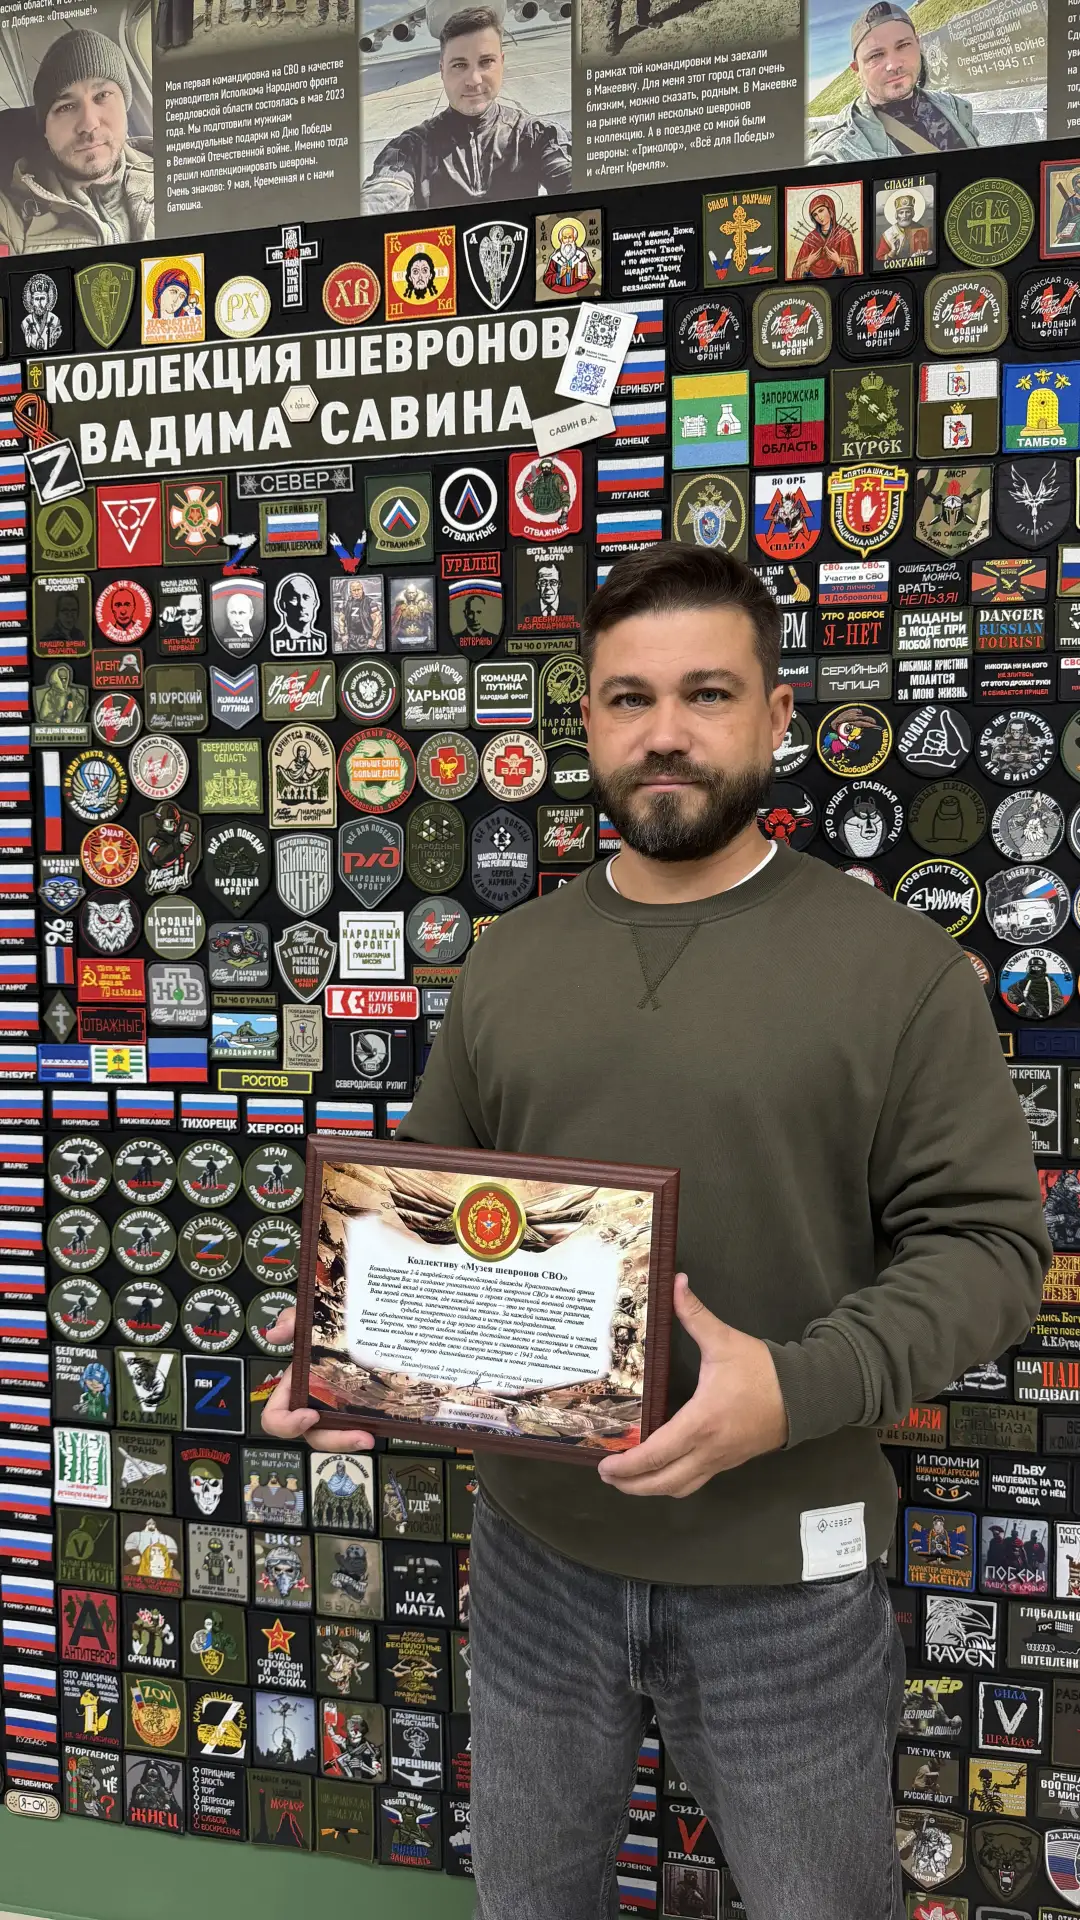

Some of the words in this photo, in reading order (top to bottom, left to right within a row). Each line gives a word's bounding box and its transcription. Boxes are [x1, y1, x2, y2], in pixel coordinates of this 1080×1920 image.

[2, 19, 9, 28] от
[12, 15, 44, 28] Добряка:
[47, 5, 97, 20] «Отважные!»
[958, 48, 1013, 67] Отечественной
[1016, 36, 1045, 53] войне
[587, 69, 592, 80] В
[595, 68, 626, 81] рамках
[629, 63, 643, 75] той
[645, 56, 711, 73] командировки
[714, 54, 728, 64] мы
[731, 49, 767, 62] заехали
[967, 57, 1019, 76] 1941-1945
[165, 80, 181, 92] Моя
[183, 77, 210, 90] первая
[213, 69, 269, 86] командировка
[272, 67, 281, 77] на
[284, 64, 299, 75] СВО
[301, 65, 305, 73] в
[308, 59, 344, 72] качестве
[166, 92, 218, 109] руководителя
[221, 85, 263, 99] Исполкома
[266, 81, 307, 93] Народного
[310, 75, 337, 91] фронта
[166, 105, 220, 123] Свердловской
[223, 103, 253, 115] области
[255, 98, 298, 110] состоялась
[301, 96, 305, 104] в
[308, 94, 323, 103] мае
[326, 88, 345, 101] 2023
[884, 178, 914, 190] СПАСИ
[919, 176, 926, 187] И
[883, 256, 926, 270] СОХРАНИ
[932, 283, 979, 322] БЕЛГОРОДСКАЯ
[978, 284, 1001, 317] ОБЛАСТЬ
[944, 324, 988, 337] НАРОДНЫЙ
[952, 334, 980, 344] ФРОНТ
[46, 342, 300, 404] КОЛЛЕКЦИЯ
[316, 316, 570, 379] ШЕВРОНОВ
[761, 388, 819, 405] ЗАПОРОЖСКАЯ
[80, 406, 292, 468] ВАДИМА
[320, 386, 534, 444] САВИНА
[549, 420, 579, 437] САВИН
[581, 415, 598, 429] В.А.
[615, 437, 650, 447] ДОНЕЦК
[762, 440, 817, 455] ОБЛАСТЬ
[1017, 436, 1068, 448] ТАМБОВ
[787, 476, 806, 485] ОРБ
[843, 468, 894, 479] «ПЯТНАШКА»
[260, 472, 330, 492] СЕВЕР
[265, 504, 323, 514] ЕКАТЕРИНБУРГ
[836, 495, 889, 545] ИНТЕРНАЦИОНАЛЬНАЯ
[887, 494, 900, 532] БРИГАДА
[442, 523, 497, 543] ОТВАЖНЫЕ
[523, 524, 569, 537] ОТВАЖНЫЕ
[770, 542, 806, 551] СПАРТА
[446, 556, 497, 573] УРАЛЕЦ
[898, 563, 956, 574] ОШИБАТЬСЯ
[922, 572, 962, 583] МОЖНО,
[899, 592, 959, 605] НЕЛЬЗЯ!
[821, 612, 846, 621] УТРО
[848, 611, 884, 620] ДОБРОЕ
[902, 611, 963, 625] ПАЦАНЫ
[979, 608, 1044, 622] DANGER
[823, 621, 882, 646] Я-НЕТ
[899, 628, 906, 637] В
[909, 625, 941, 637] МОДЕ
[946, 624, 966, 635] ПРИ
[979, 622, 1043, 637] RUSSIAN
[276, 639, 322, 652] PUTIN
[898, 636, 931, 651] ЛЮБОЙ
[933, 636, 968, 649] ПОГОДЕ
[978, 636, 1043, 649] TOURIST
[96, 660, 120, 672] АГЕНТ
[822, 662, 888, 676] СЕРИЙНЫЙ
[898, 660, 932, 672] ЛЮБИМАЯ
[934, 658, 968, 670] КРИСТИНА
[96, 675, 138, 686] КРЕМЛЯ
[407, 662, 440, 686] РУССКИЙ
[440, 662, 463, 684] ГОРОД
[480, 674, 528, 682] КОМАНДА
[910, 674, 955, 686] МОЛИТСЯ
[486, 682, 523, 691] ПУТИНА
[829, 680, 880, 690] ТУПИЦА
[150, 694, 156, 704] Я
[158, 690, 202, 704] КУРСКИЙ
[406, 688, 466, 702] ХАРЬКОВ
[898, 689, 910, 700] ЗА
[914, 688, 934, 700] МОЮ
[938, 686, 968, 699] ЖИЗНЬ
[898, 705, 936, 752] ОБОЮДНО
[202, 742, 258, 752] СВЕРДЛОВСКАЯ
[214, 753, 247, 763] ОБЛАСТЬ
[554, 769, 590, 784] ЕКБ
[215, 878, 259, 887] НАРОДНЫЙ
[900, 864, 970, 893] ПОВЕЛИТЕЛЬ
[223, 886, 251, 896] ФРОНТ
[45, 918, 66, 945] 96
[66, 920, 74, 944] RUS
[368, 991, 413, 1002] КУЛИБИН
[368, 1003, 393, 1014] КЛУБ
[83, 1017, 141, 1033] ОТВАЖНЫЕ
[242, 1075, 289, 1087] РОСТОВ
[335, 1079, 382, 1090] СЕВЕРОДОНЕЦК
[386, 1080, 407, 1090] РУЛИТ
[120, 1118, 170, 1126] НИЖНЕКАМСК
[182, 1118, 236, 1130] ТИХОРЕЦК
[247, 1124, 304, 1134] ХЕРСОН
[57, 1137, 105, 1156] САМАРА
[116, 1140, 174, 1167] ВОЛГОГРАД
[185, 1142, 234, 1164] МОСКВА
[263, 1148, 288, 1158] УРАЛ
[118, 1210, 170, 1234] КАЛИНИНГРАД
[182, 1219, 237, 1242] ЛУГАНСКИЙ
[190, 1260, 234, 1277] ФРОНТ
[407, 1255, 458, 1270] Коллективу
[461, 1263, 493, 1274] «Музея
[495, 1267, 540, 1279] шевронов
[542, 1271, 568, 1281] СВО»
[127, 1282, 164, 1296] ТВЕРЬ
[184, 1288, 241, 1318] СТАВРОПОЛЬ
[56, 1346, 97, 1358] БЕЛГОРОД
[56, 1364, 84, 1373] ЗВУЧИТ
[56, 1373, 80, 1381] ГОРДО
[122, 1410, 177, 1425] САХАЛИН
[118, 1435, 165, 1447] ПЕРЕШЛИ
[127, 1445, 158, 1455] ГРАНЬ
[917, 1455, 926, 1464] И
[929, 1455, 979, 1468] ПОМНИ
[1012, 1464, 1047, 1476] ЛЬВУ
[119, 1488, 168, 1500] ЗАРЯЖАЙ
[119, 1498, 166, 1508] «ГЕРАНЬ»
[1016, 1496, 1041, 1507] ОВЦА
[405, 1591, 435, 1603] UAZ
[396, 1603, 445, 1618] MAFIA
[64, 1646, 115, 1663] АНТИТЕРРОР
[128, 1654, 151, 1666] ОРКИ
[152, 1657, 176, 1668] ИДУТ
[926, 1643, 996, 1668] RAVEN
[258, 1674, 306, 1688] РУССКИХ
[65, 1745, 119, 1762] ВТОРГАЕМСЯ
[392, 1758, 442, 1771] ОРЕШНИК
[12, 1778, 53, 1790] ЧЕЛЯБИНСК
[903, 1791, 932, 1802] РУССКИЕ
[934, 1793, 953, 1804] ИДУТ
[131, 1808, 179, 1829] ЖНЕЦ
[668, 1851, 715, 1864] ПРАВДЕ
